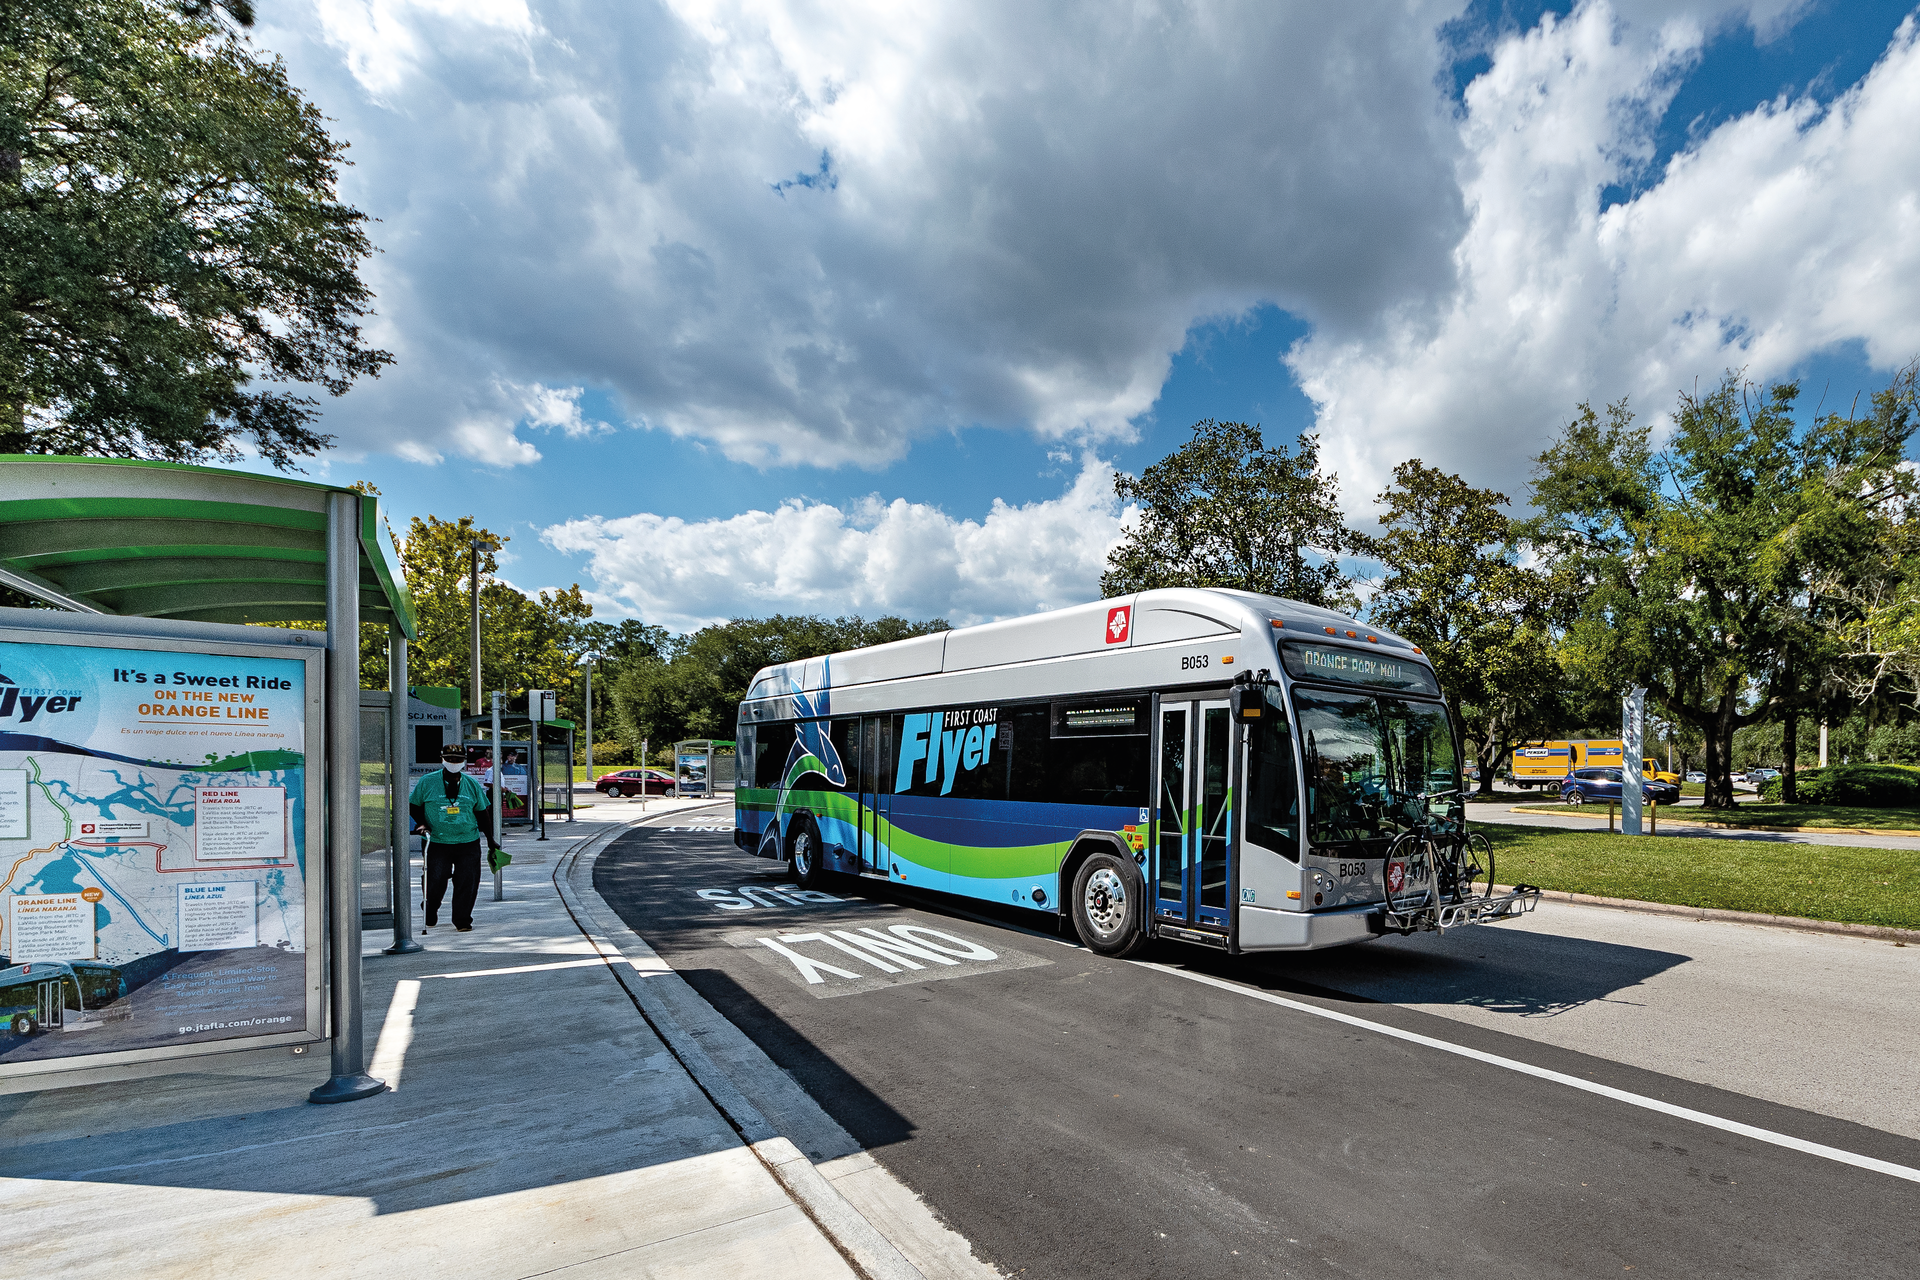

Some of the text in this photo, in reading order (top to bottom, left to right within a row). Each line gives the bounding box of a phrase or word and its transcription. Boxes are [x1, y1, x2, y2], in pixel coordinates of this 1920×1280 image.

[1181, 655, 1209, 670] B053
[1352, 658, 1376, 674] PARK
[113, 669, 292, 690] It's a Sweet Ride
[154, 690, 255, 703] ON THE NEW
[0, 687, 82, 723] lyer
[138, 704, 269, 720] ORANGE LINE
[944, 708, 998, 728] FIRST COAST
[145, 728, 164, 736] viaje
[895, 711, 997, 796] Flyer
[1339, 862, 1366, 878] B053
[697, 884, 845, 910] BUS
[755, 925, 998, 984] ONLY
[209, 977, 244, 986] Reliable
[177, 988, 204, 998] Travel
[207, 986, 240, 995] Around
[179, 1015, 292, 1034] go.jtafla.com/orange
